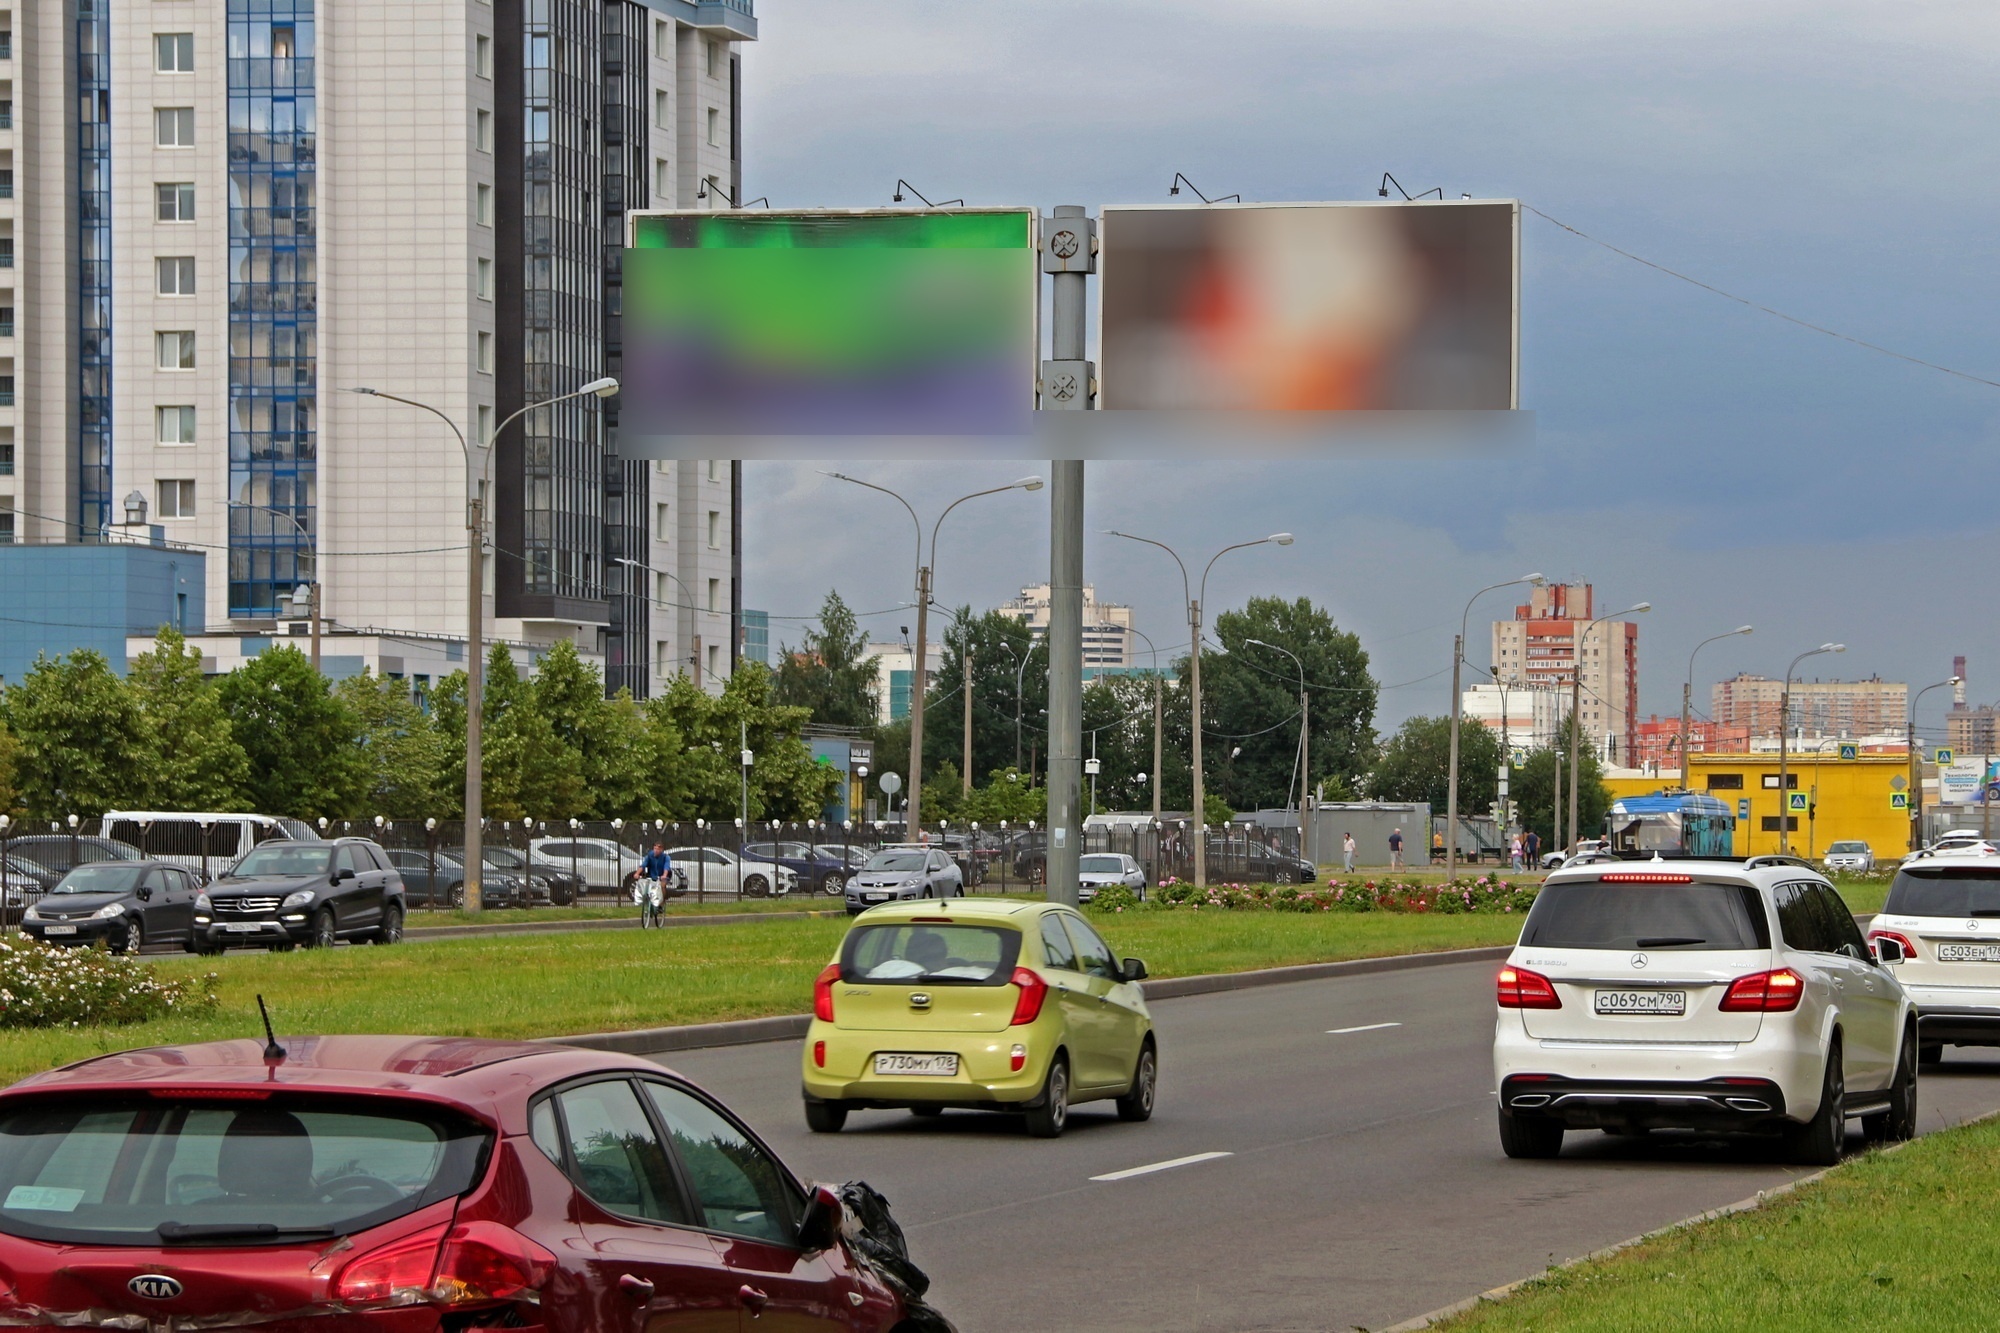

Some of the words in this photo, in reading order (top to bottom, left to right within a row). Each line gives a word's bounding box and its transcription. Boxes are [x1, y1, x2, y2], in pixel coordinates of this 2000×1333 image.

[1600, 993, 1657, 1008] С069СМ
[1658, 993, 1681, 1005] 790
[934, 1056, 953, 1067] 178
[135, 1280, 175, 1296] KIA
